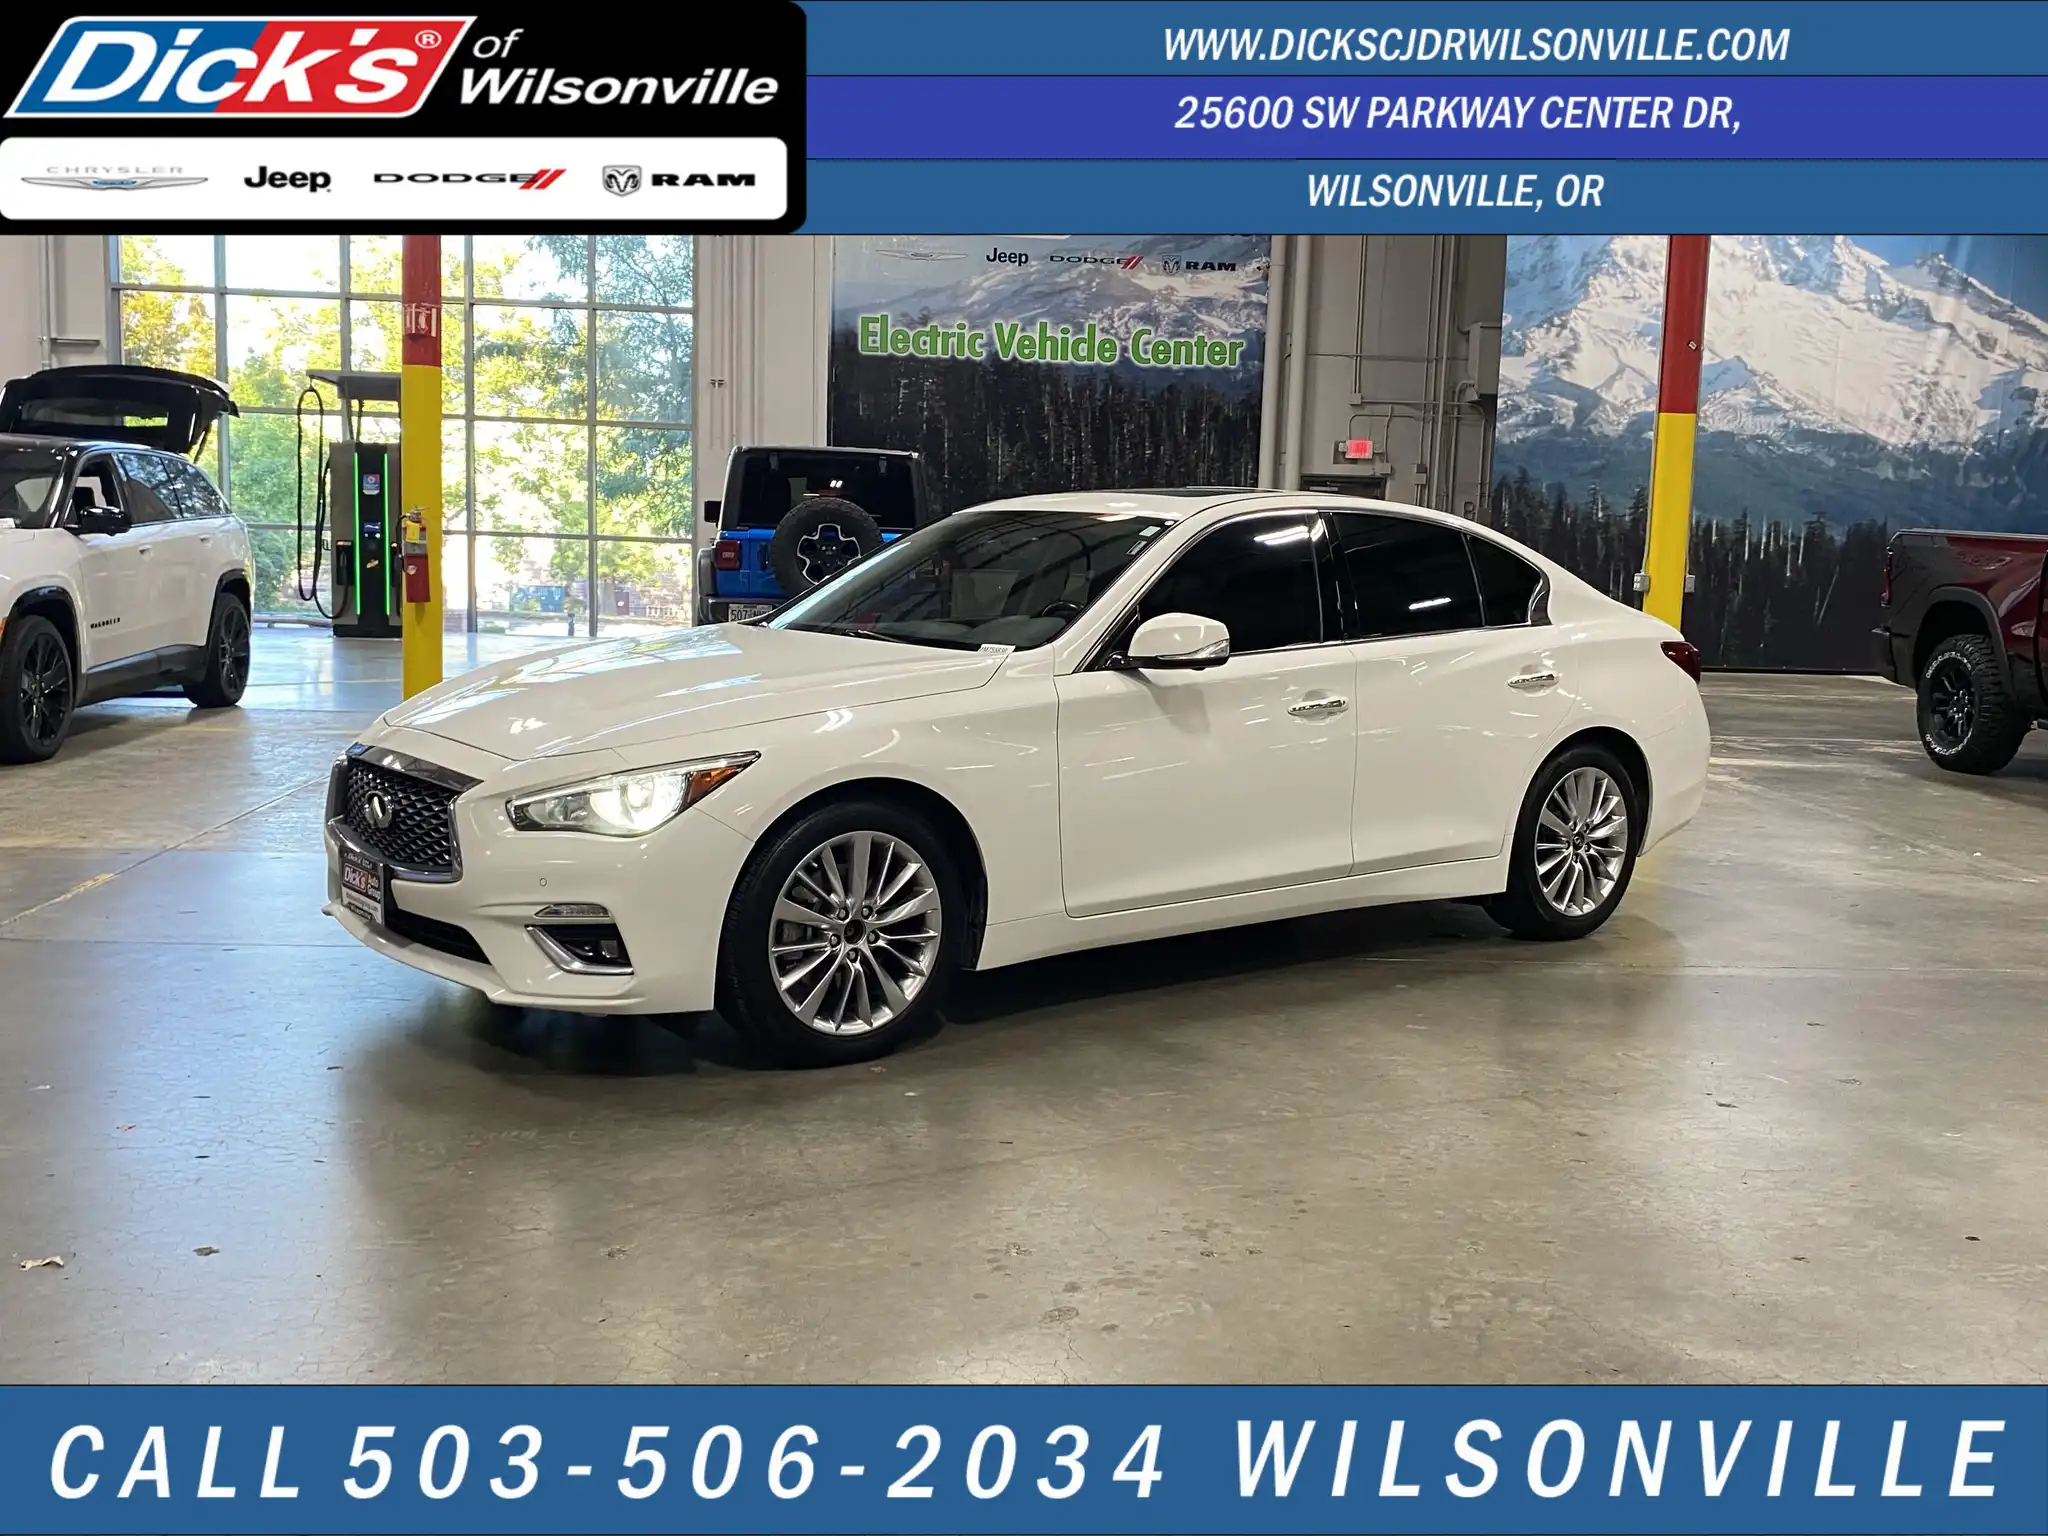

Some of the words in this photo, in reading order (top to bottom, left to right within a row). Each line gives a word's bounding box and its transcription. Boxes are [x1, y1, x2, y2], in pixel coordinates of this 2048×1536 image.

[986, 247, 1029, 267] Jeep
[1049, 254, 1129, 265] DODGE
[1185, 261, 1237, 272] RAM
[860, 314, 984, 358] Electric
[995, 321, 1117, 364] Vehicle
[1131, 328, 1244, 366] Center
